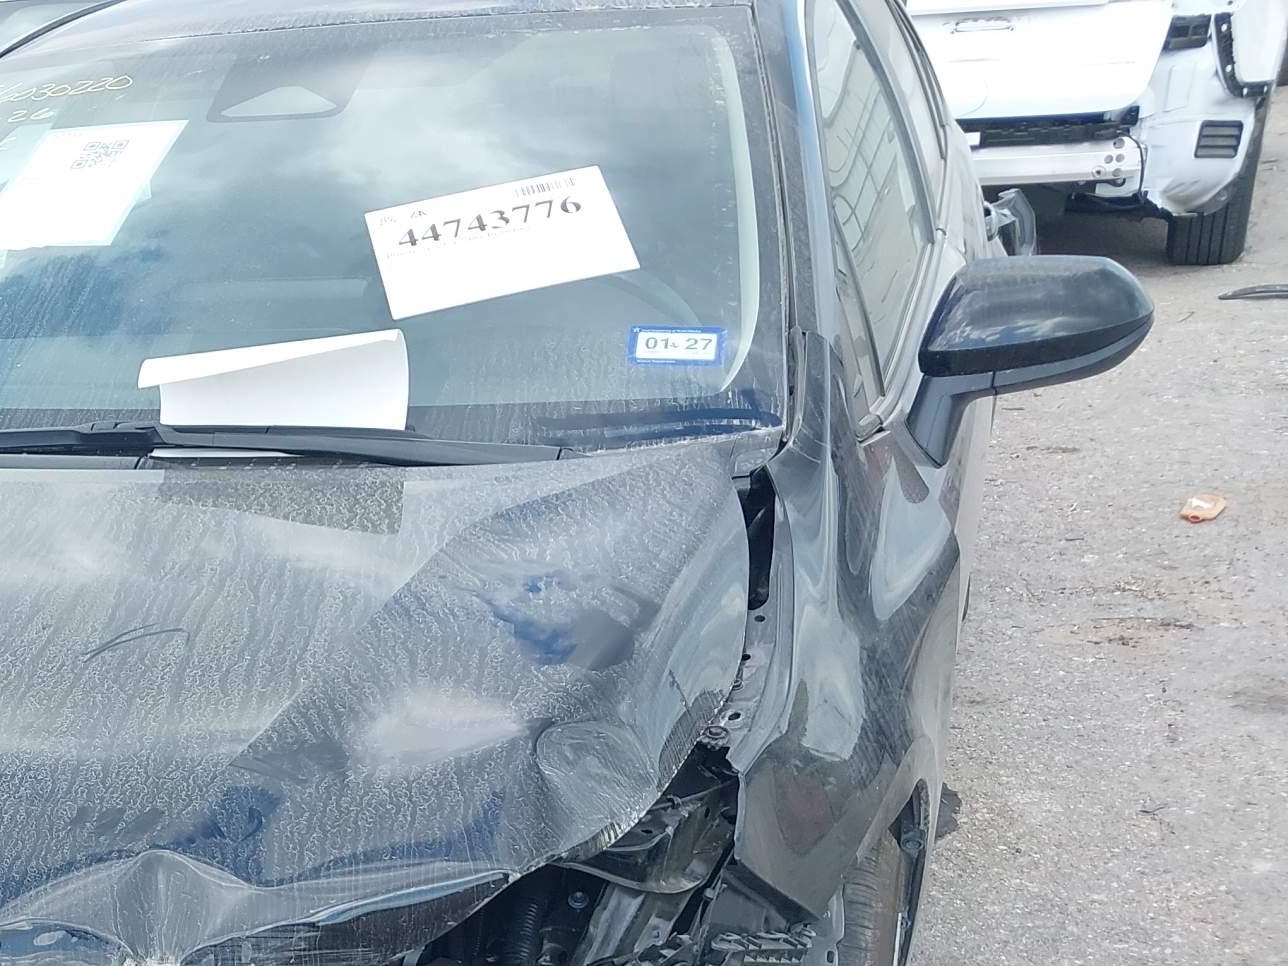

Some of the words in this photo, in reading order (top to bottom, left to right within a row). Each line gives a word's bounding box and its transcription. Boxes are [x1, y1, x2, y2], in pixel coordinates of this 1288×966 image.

[398, 197, 581, 246] 44743776
[645, 337, 669, 350] 01
[684, 337, 713, 350] 27
